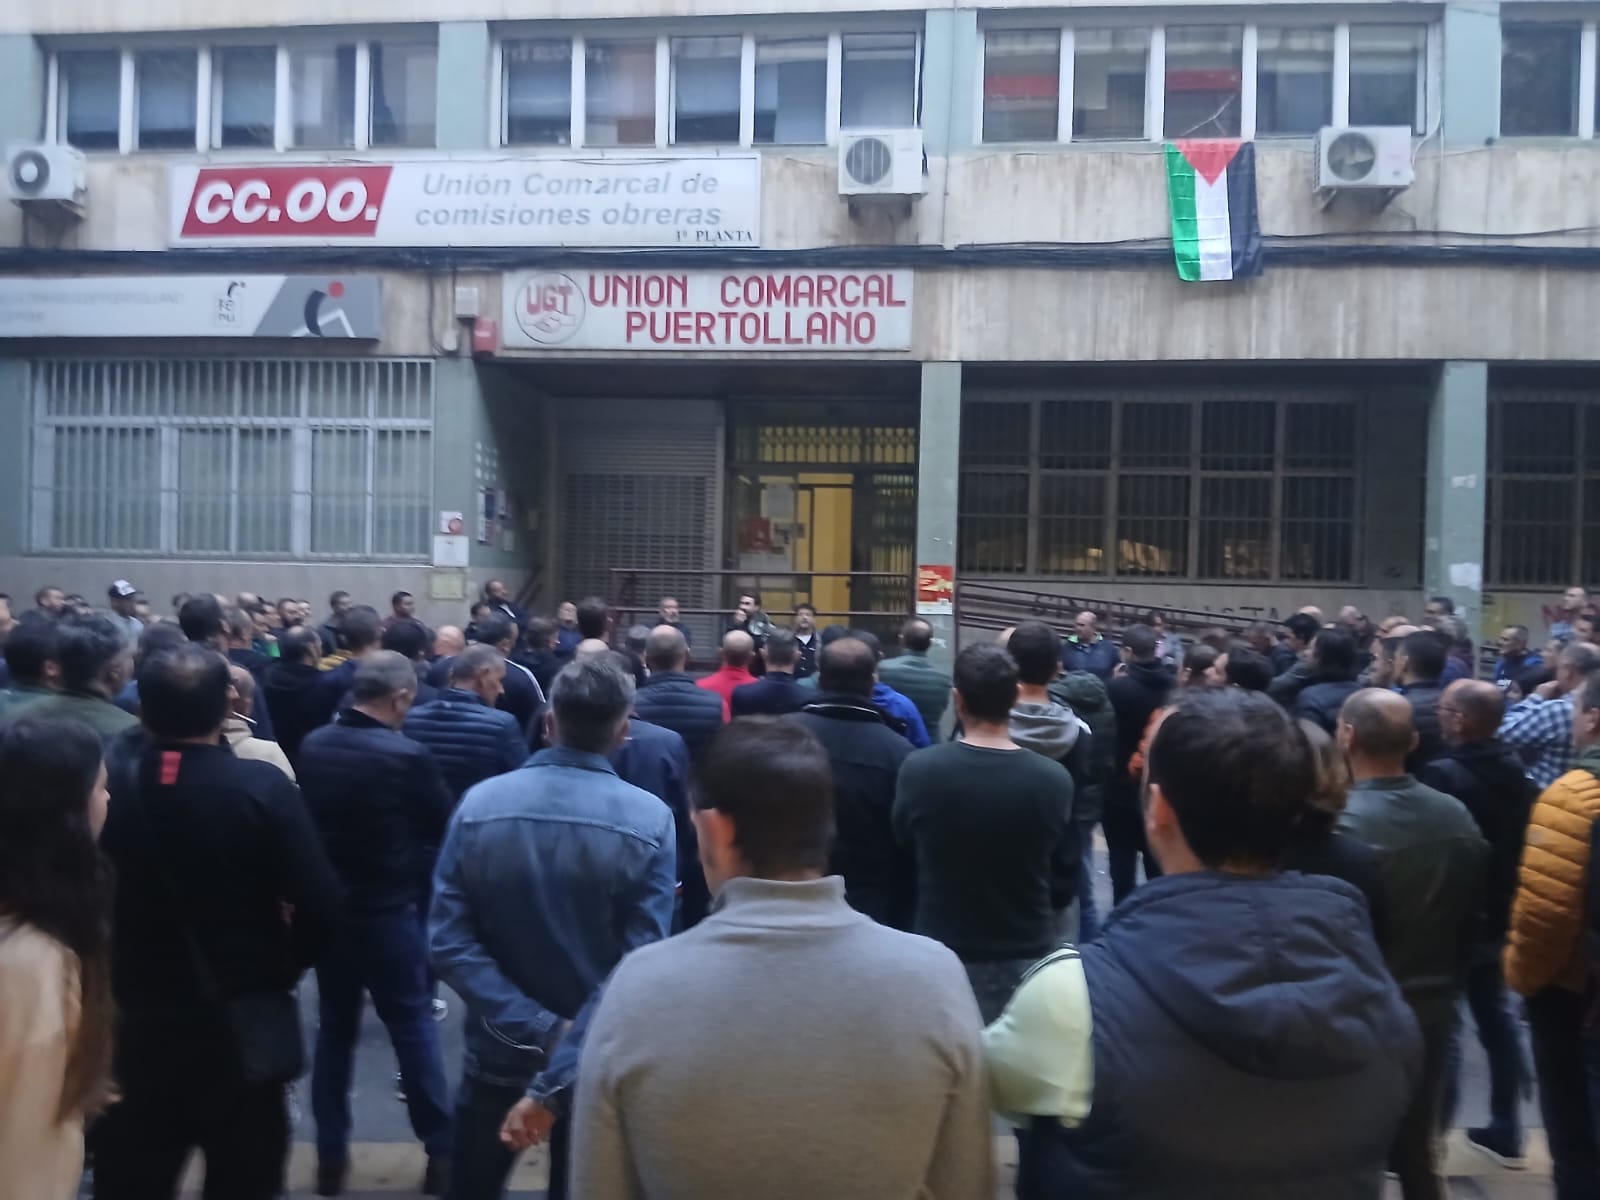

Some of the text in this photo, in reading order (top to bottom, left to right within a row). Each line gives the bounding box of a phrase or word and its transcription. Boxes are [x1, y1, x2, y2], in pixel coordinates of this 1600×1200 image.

[422, 170, 719, 198] Unión Comarcal de
[194, 177, 379, 225] CC.OO.
[415, 201, 722, 229] comisiones obreras
[695, 230, 753, 242] PLANTA
[525, 284, 574, 315] UGT
[588, 274, 907, 308] UNION COMARCAL
[626, 311, 877, 345] PUERTOLLANO
